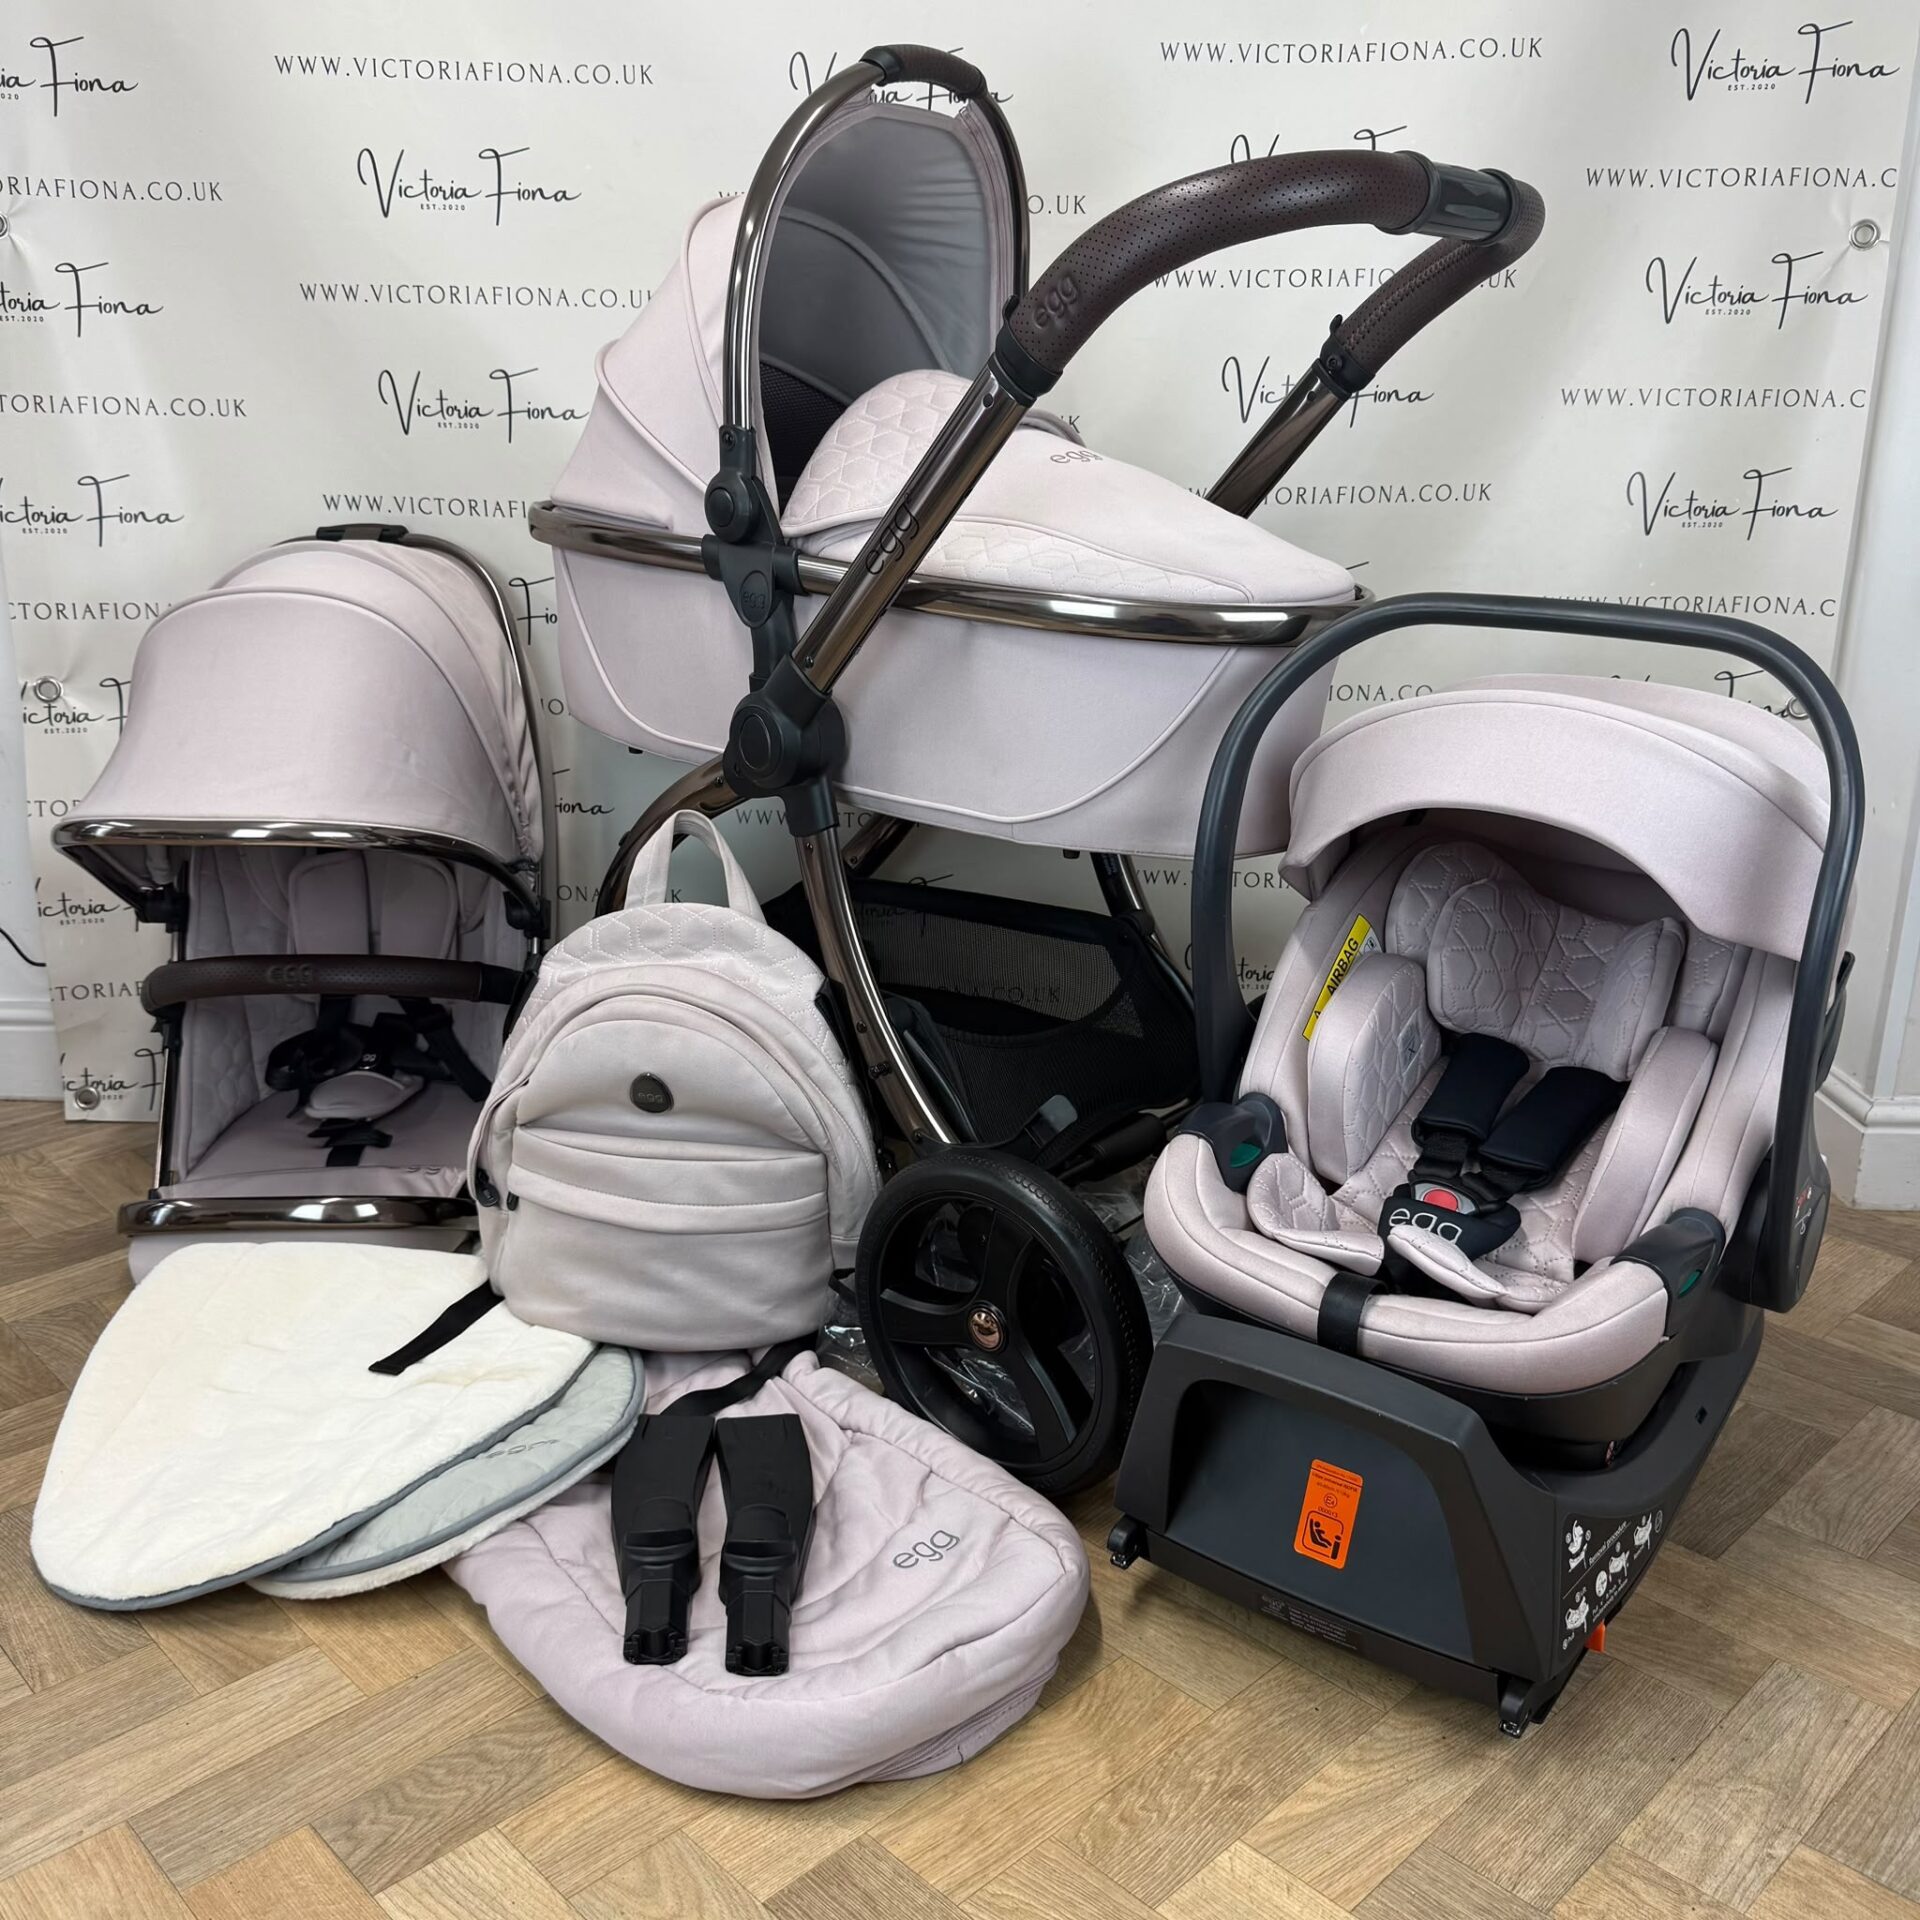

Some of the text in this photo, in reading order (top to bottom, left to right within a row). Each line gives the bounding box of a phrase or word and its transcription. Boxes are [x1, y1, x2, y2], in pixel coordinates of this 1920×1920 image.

[30, 37, 138, 117] Fiona
[274, 55, 653, 84] WWW.VICTORIAFIONA.CO.UK
[1161, 37, 1542, 63] WWW.VICTORIAFIONA.CO.UK
[1671, 21, 1899, 104] Victoria Fiona
[1728, 83, 1776, 92] EST.2020
[357, 147, 582, 226] Victoria Fiona
[1586, 167, 1897, 188] WWW.VICTORIAFIONA.C
[420, 203, 466, 211] EST.2020
[55, 262, 163, 337] Fiona
[1033, 273, 1078, 330] egg
[1646, 251, 1868, 329] Victoria Fiona
[1704, 308, 1751, 316] EST.2020
[378, 368, 589, 443] Victoria Fiona
[1561, 388, 1866, 408] WWW.VICTORIAFIONA.C
[0, 474, 184, 547] ictoria Fiona
[22, 527, 68, 535] EST.2020
[322, 494, 527, 518] WWW.VICTORIAFI
[1626, 467, 1839, 541] Victoria Fiona
[865, 502, 920, 575] egg
[1326, 937, 1360, 997] AIRBAG
[893, 1530, 960, 1569] egg
